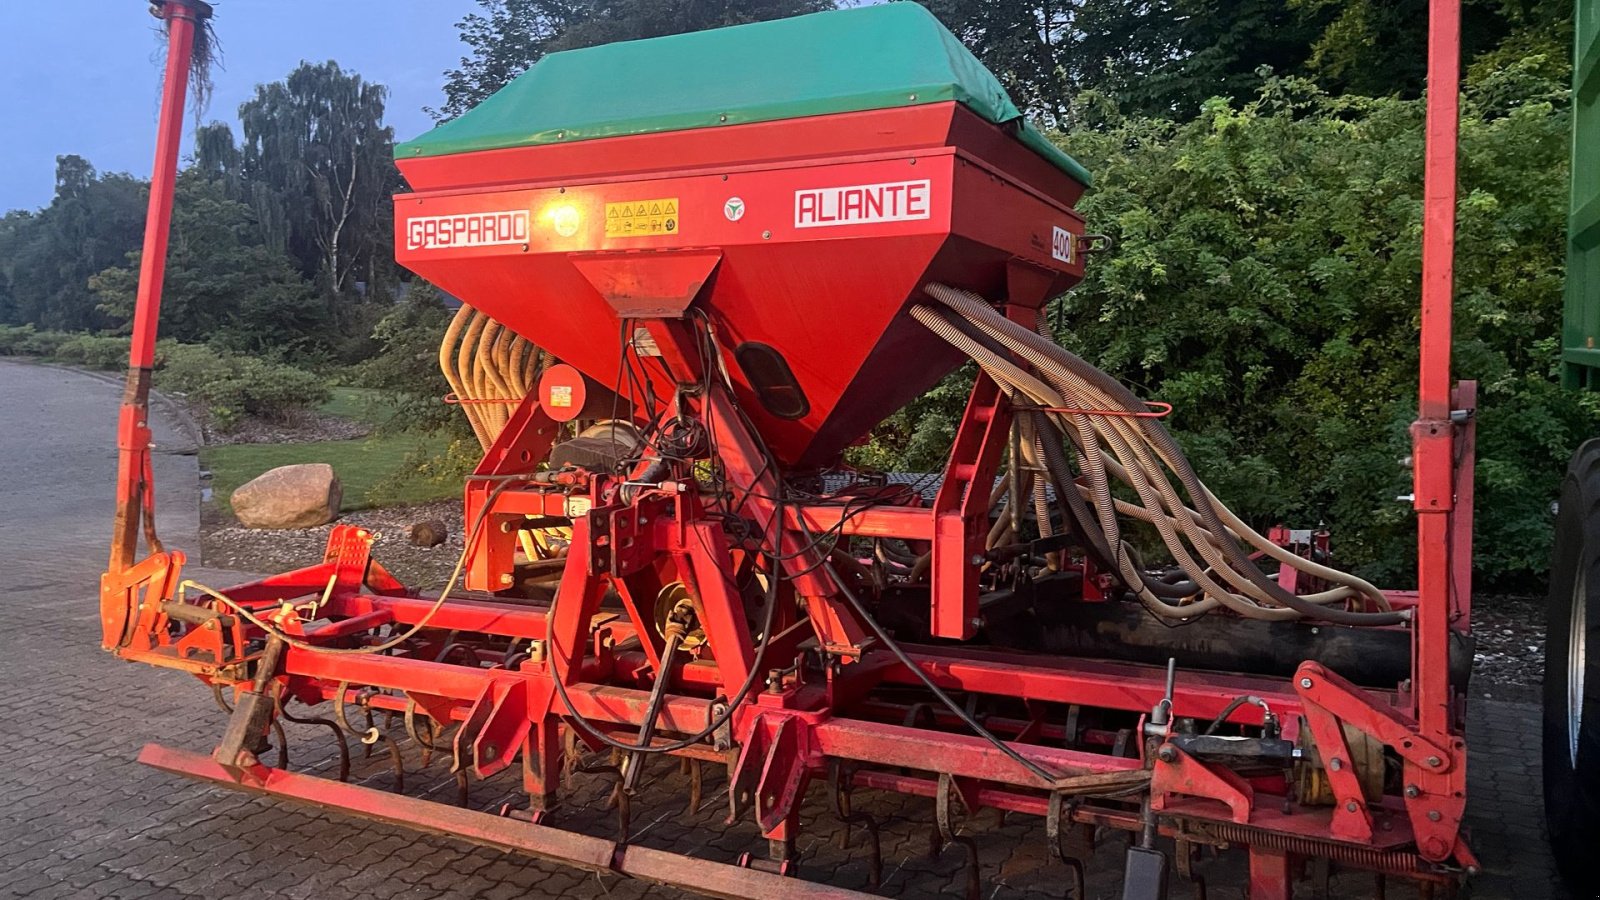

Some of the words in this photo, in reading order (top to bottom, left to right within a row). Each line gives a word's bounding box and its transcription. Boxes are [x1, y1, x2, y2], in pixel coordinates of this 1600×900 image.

[798, 183, 926, 223] ALIANTE
[409, 213, 527, 247] GASPARDO
[1053, 230, 1070, 259] 400
